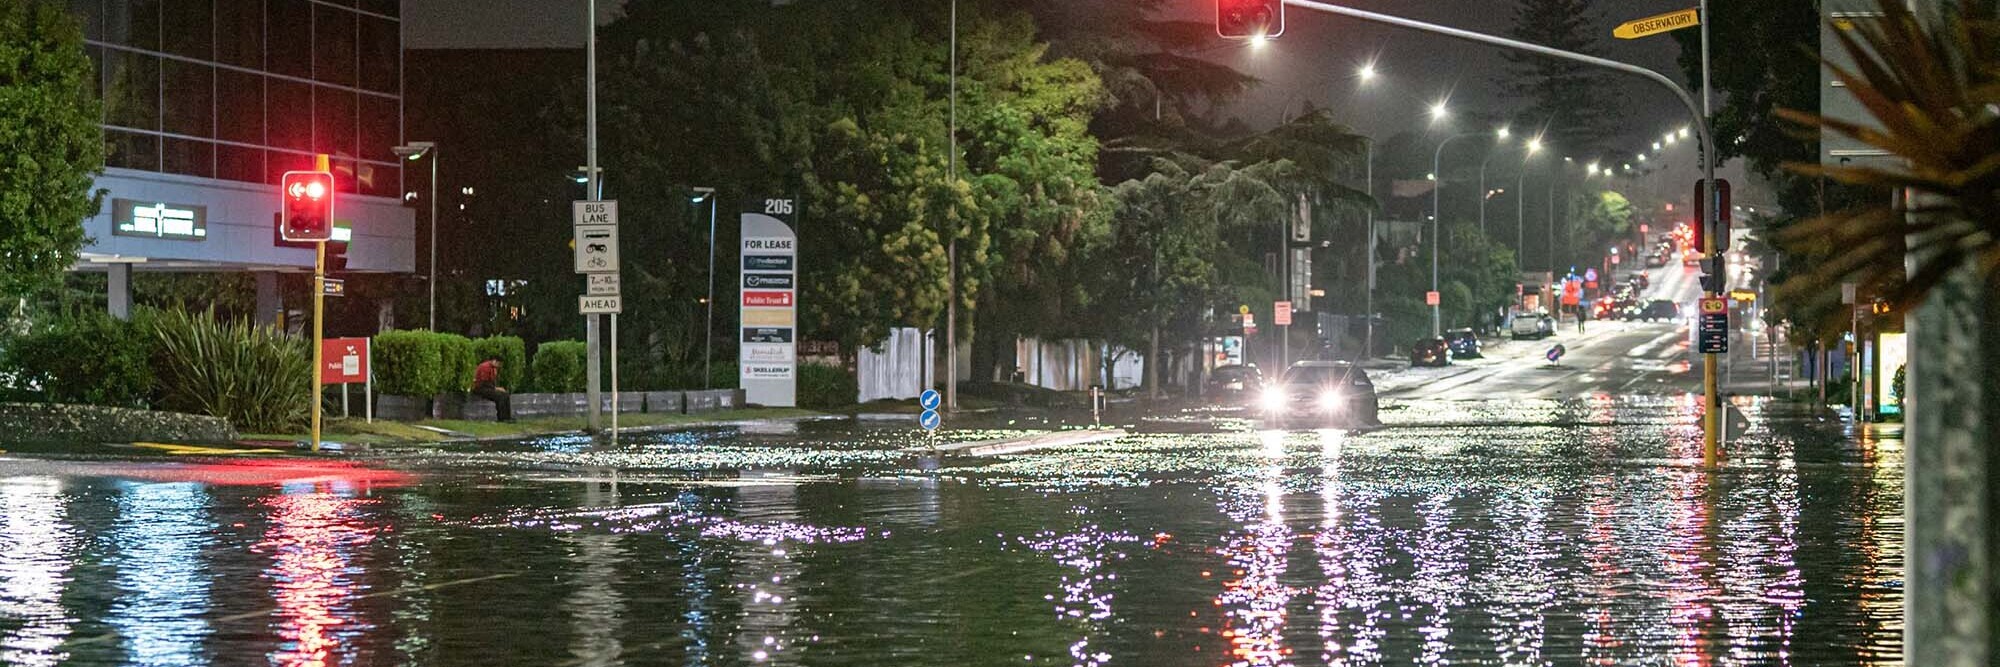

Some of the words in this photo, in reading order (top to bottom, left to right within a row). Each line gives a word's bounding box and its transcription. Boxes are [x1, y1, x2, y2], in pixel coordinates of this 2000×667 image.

[1633, 13, 1692, 34] OBSERVATORY
[585, 204, 605, 213] BUS
[765, 198, 793, 214] 205
[582, 214, 609, 223] LANE
[744, 240, 762, 249] FOR
[764, 240, 792, 249] LEASE
[584, 300, 617, 309] AHEAD
[746, 296, 765, 304] Public
[766, 296, 782, 304] Trust
